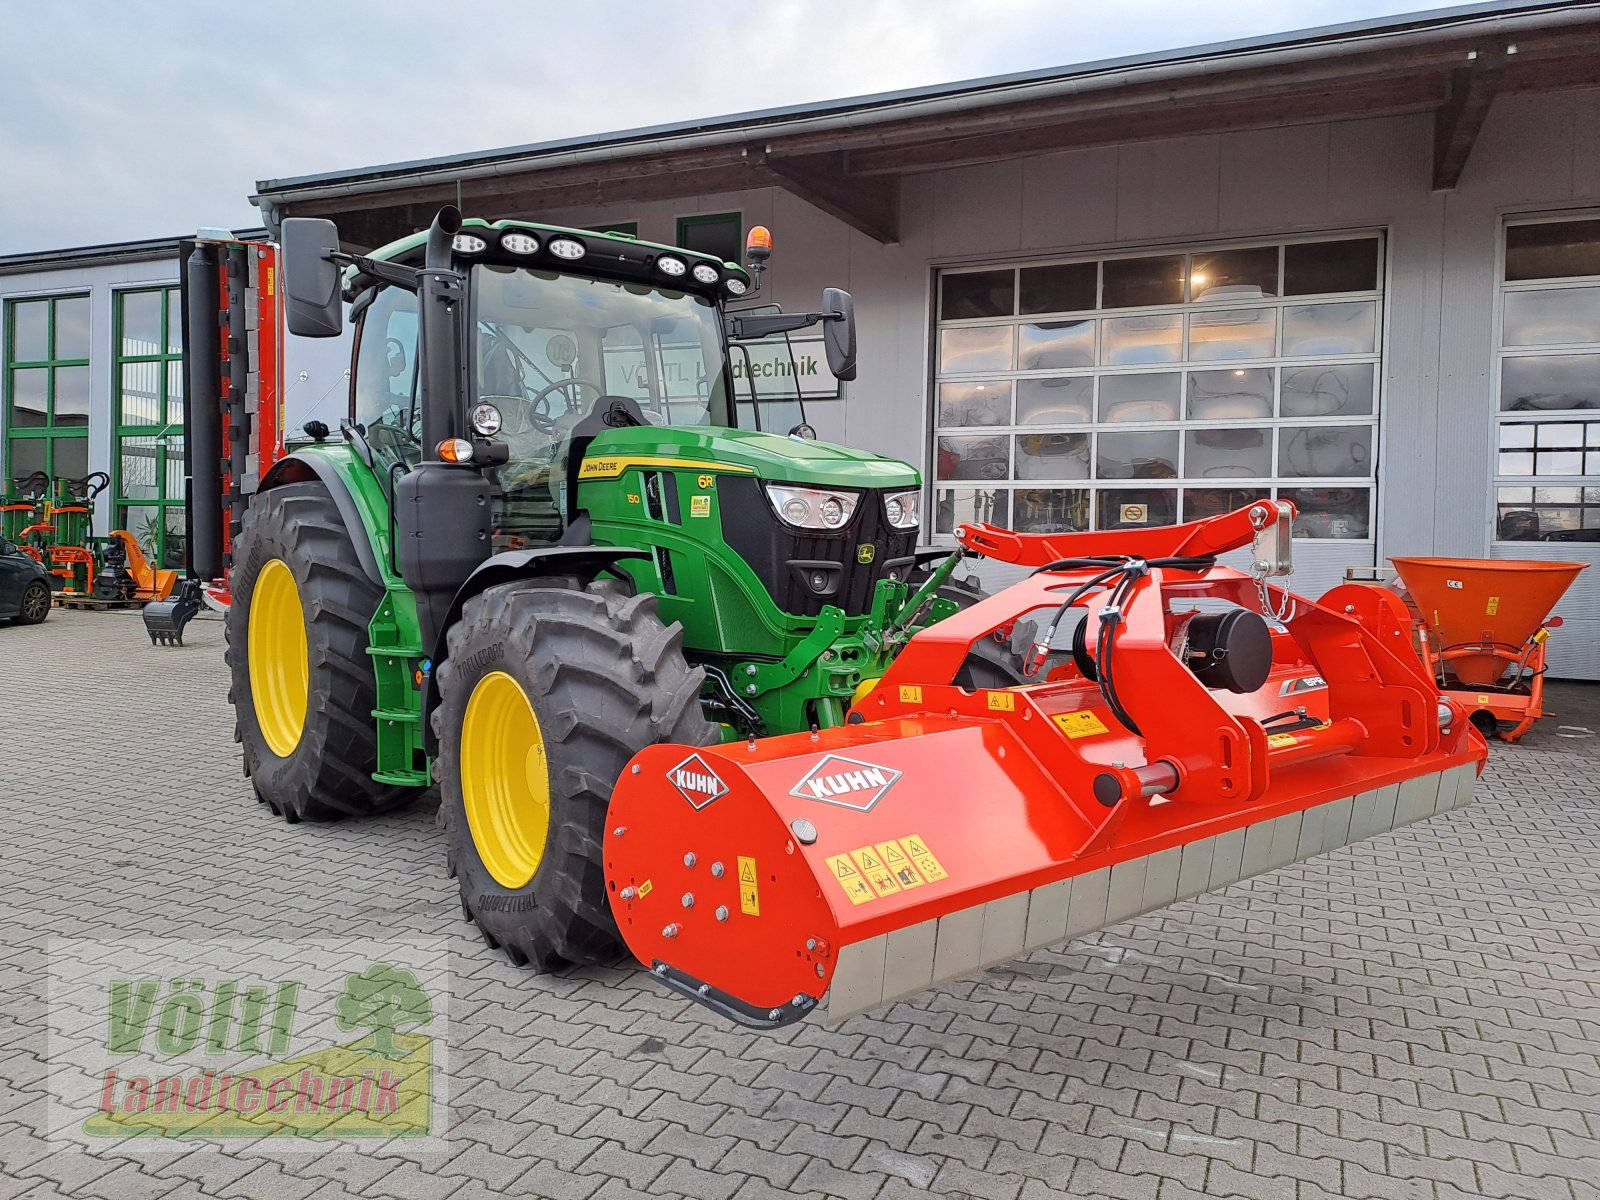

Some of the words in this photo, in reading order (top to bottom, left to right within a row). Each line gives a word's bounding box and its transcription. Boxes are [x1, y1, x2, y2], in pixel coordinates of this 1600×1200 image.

[621, 361, 689, 383] VÖTL
[584, 463, 598, 473] JOHN
[598, 461, 618, 471] DEERE
[698, 475, 714, 489] 6R
[626, 494, 640, 504] 150
[456, 641, 505, 680] TRELLEBORG
[676, 769, 718, 796] KUHN
[806, 767, 889, 799] KUHN
